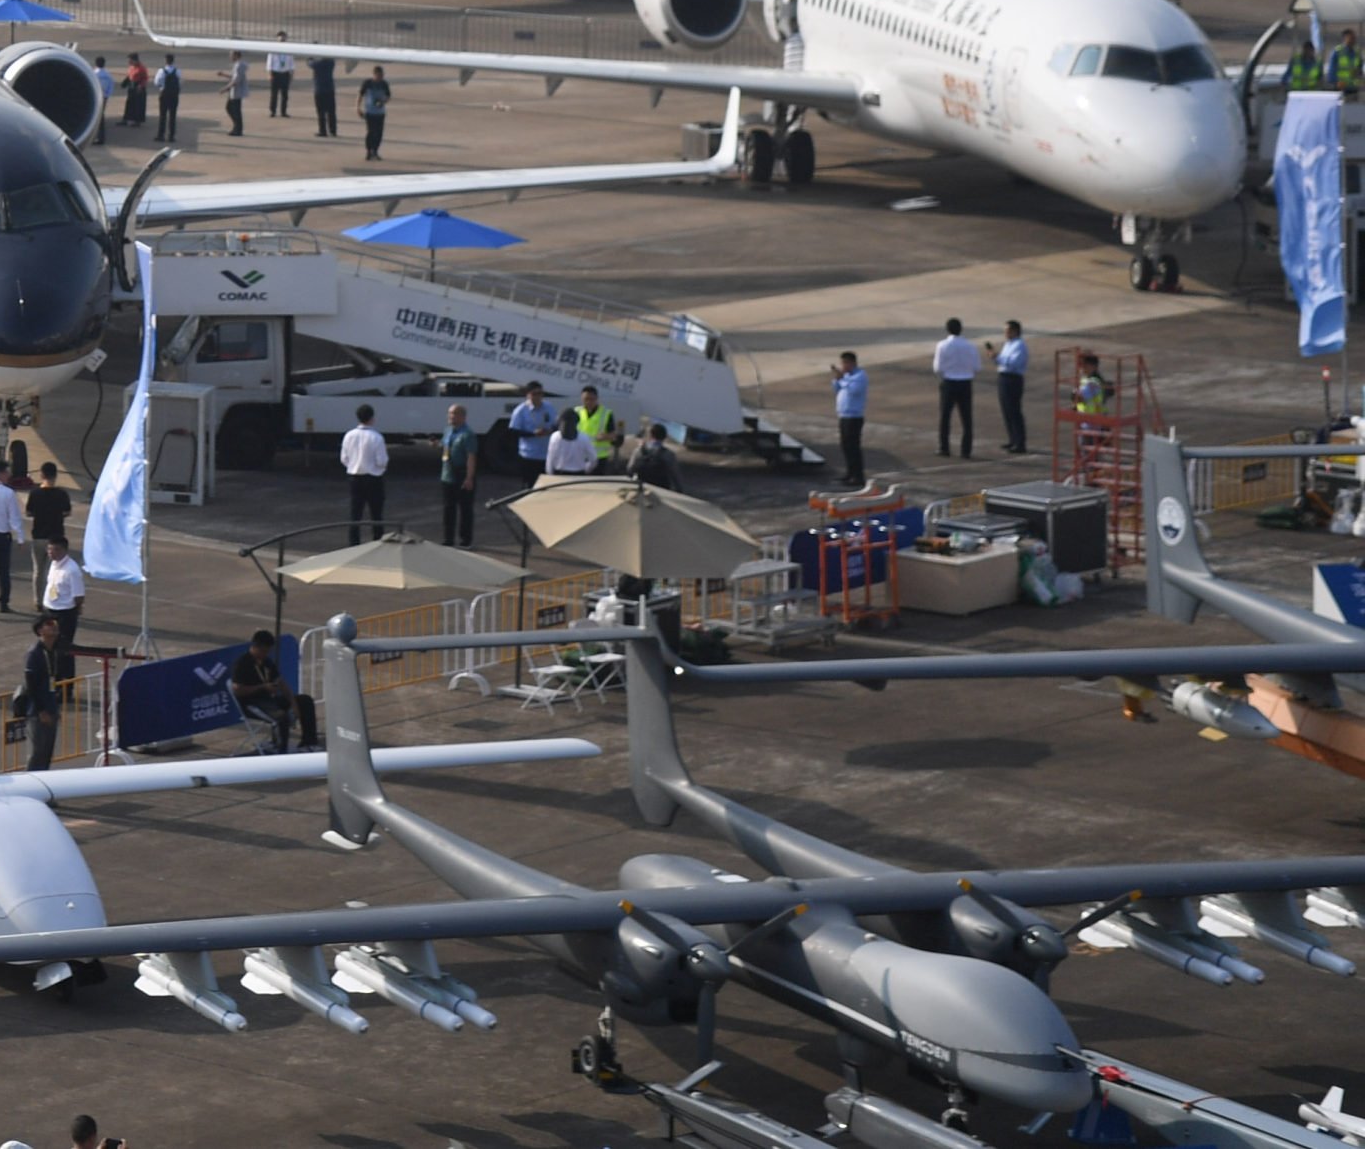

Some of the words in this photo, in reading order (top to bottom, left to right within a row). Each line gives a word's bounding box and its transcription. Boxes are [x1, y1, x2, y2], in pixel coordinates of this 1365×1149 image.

[218, 292, 269, 301] COMAC
[392, 326, 458, 352] Commercial
[459, 342, 498, 362] Aircraft
[499, 352, 562, 379] Corporation
[396, 307, 642, 381] 中国商用飞机有限责任公司
[191, 704, 229, 721] COMAC
[900, 1030, 950, 1062] TENGDEN
